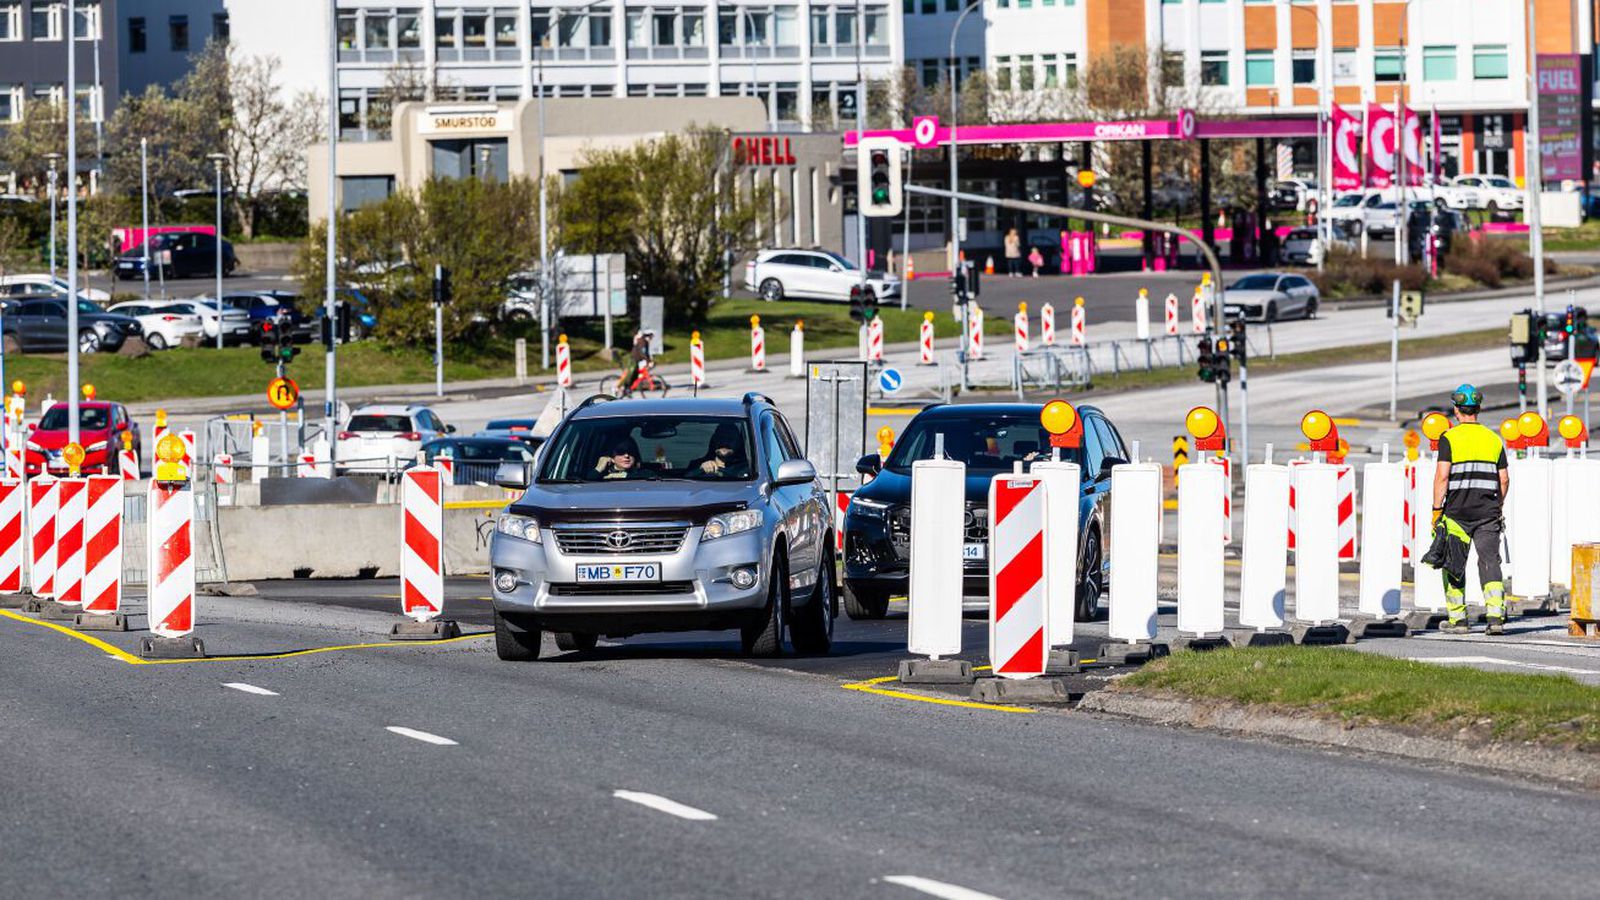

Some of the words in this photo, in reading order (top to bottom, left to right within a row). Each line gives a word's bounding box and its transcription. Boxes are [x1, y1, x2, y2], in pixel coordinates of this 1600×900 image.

[1539, 70, 1578, 90] FUEL
[1094, 124, 1146, 137] ORKAN
[588, 566, 611, 579] MB
[624, 565, 655, 579] F70
